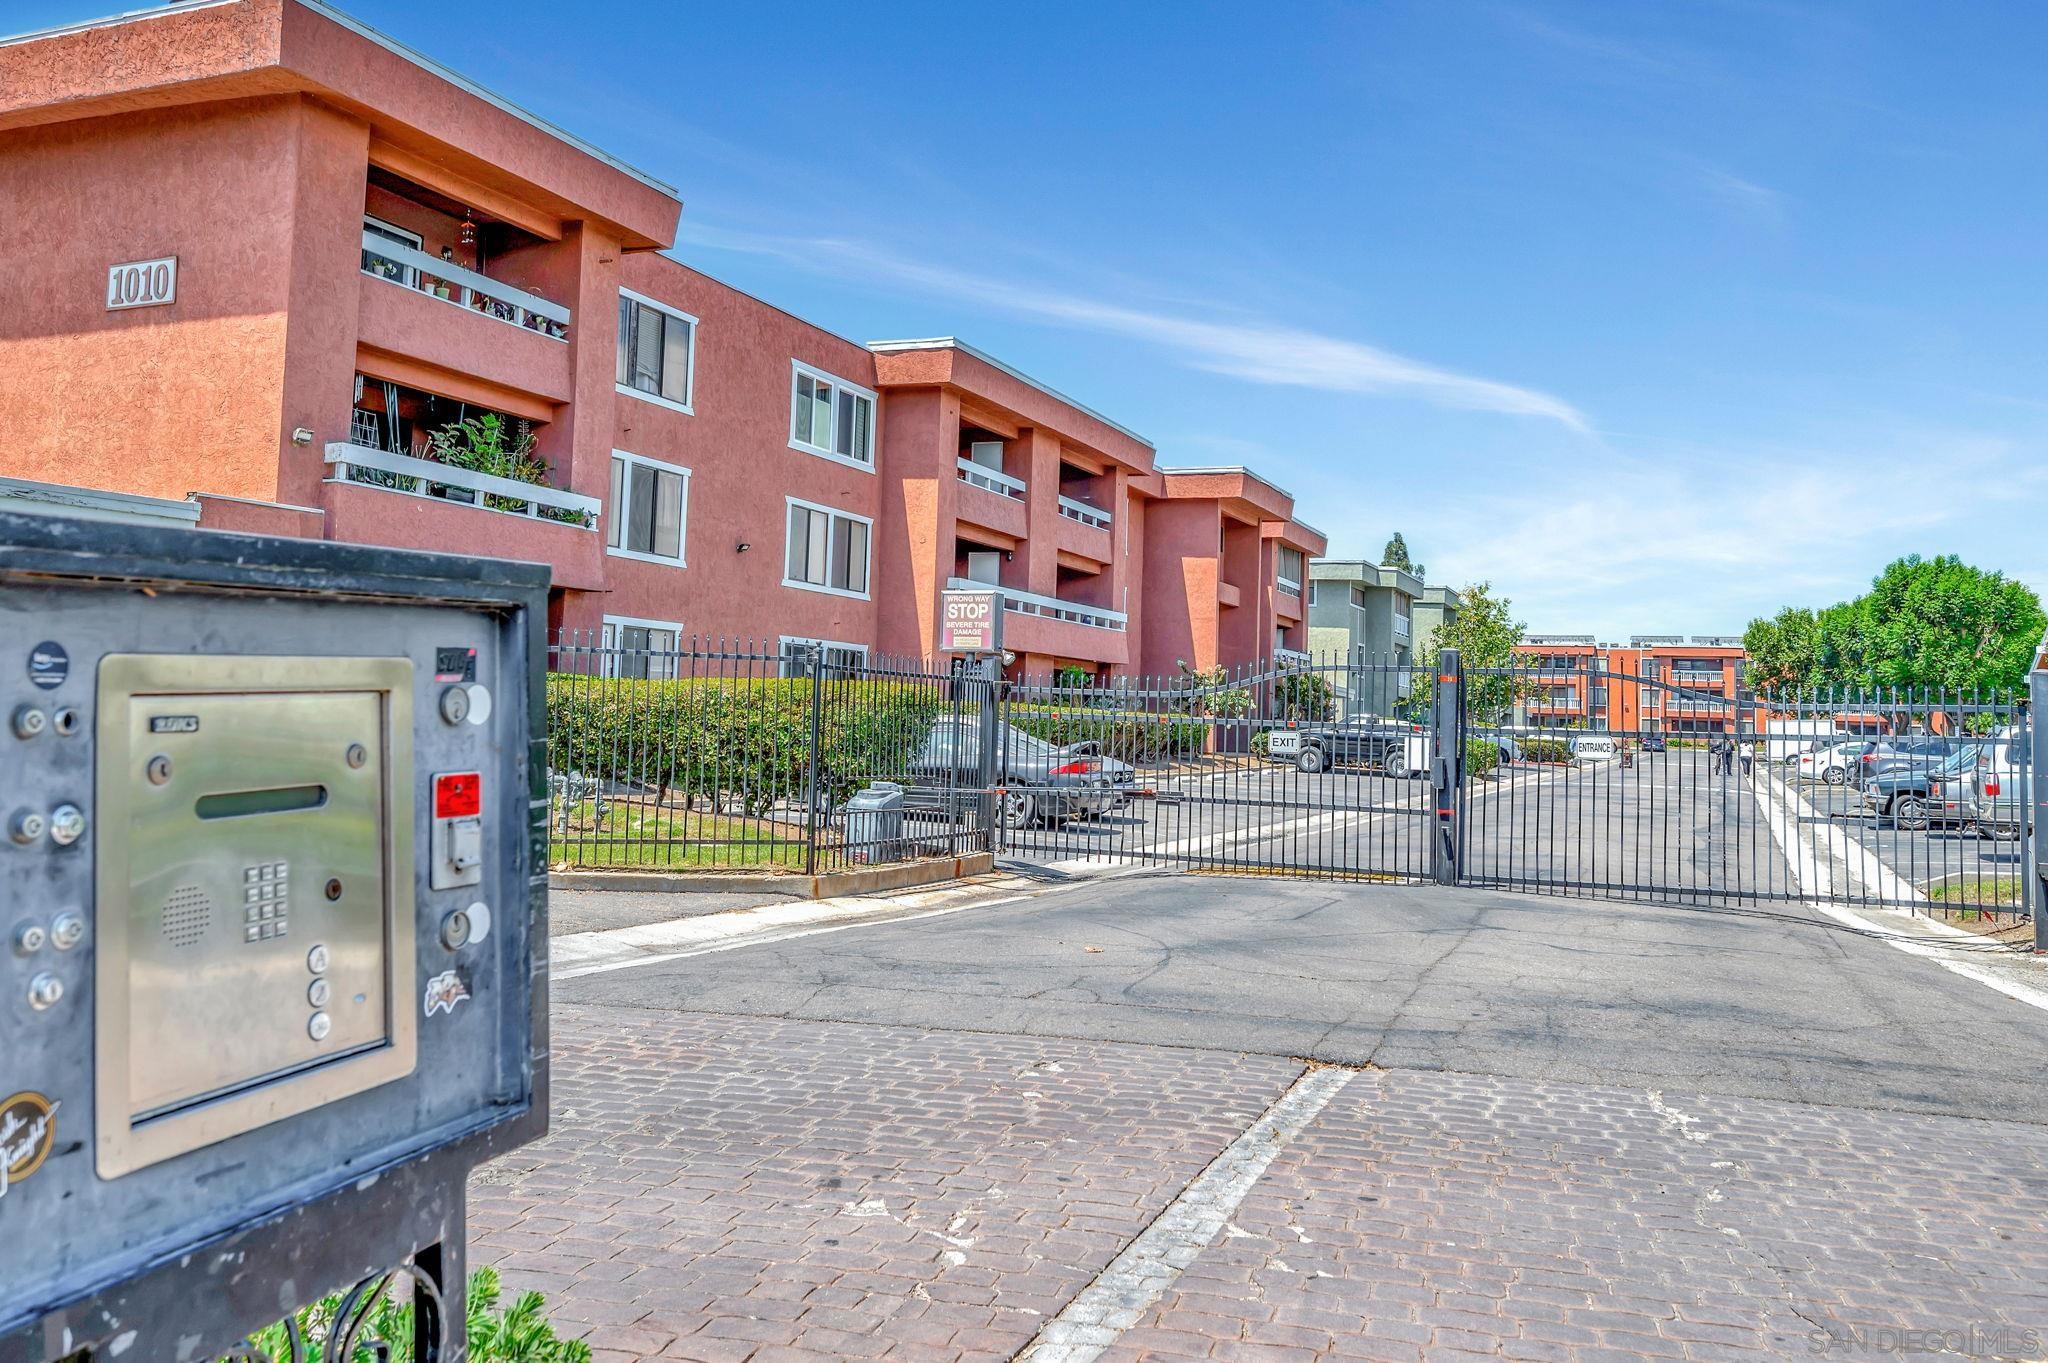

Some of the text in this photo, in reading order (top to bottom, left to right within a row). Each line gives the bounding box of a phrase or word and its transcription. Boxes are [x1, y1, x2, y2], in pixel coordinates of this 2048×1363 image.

[111, 264, 169, 305] 1010
[947, 603, 989, 619] STOP
[1272, 738, 1296, 747] EXIT
[1578, 742, 1611, 753] ENTRANCE
